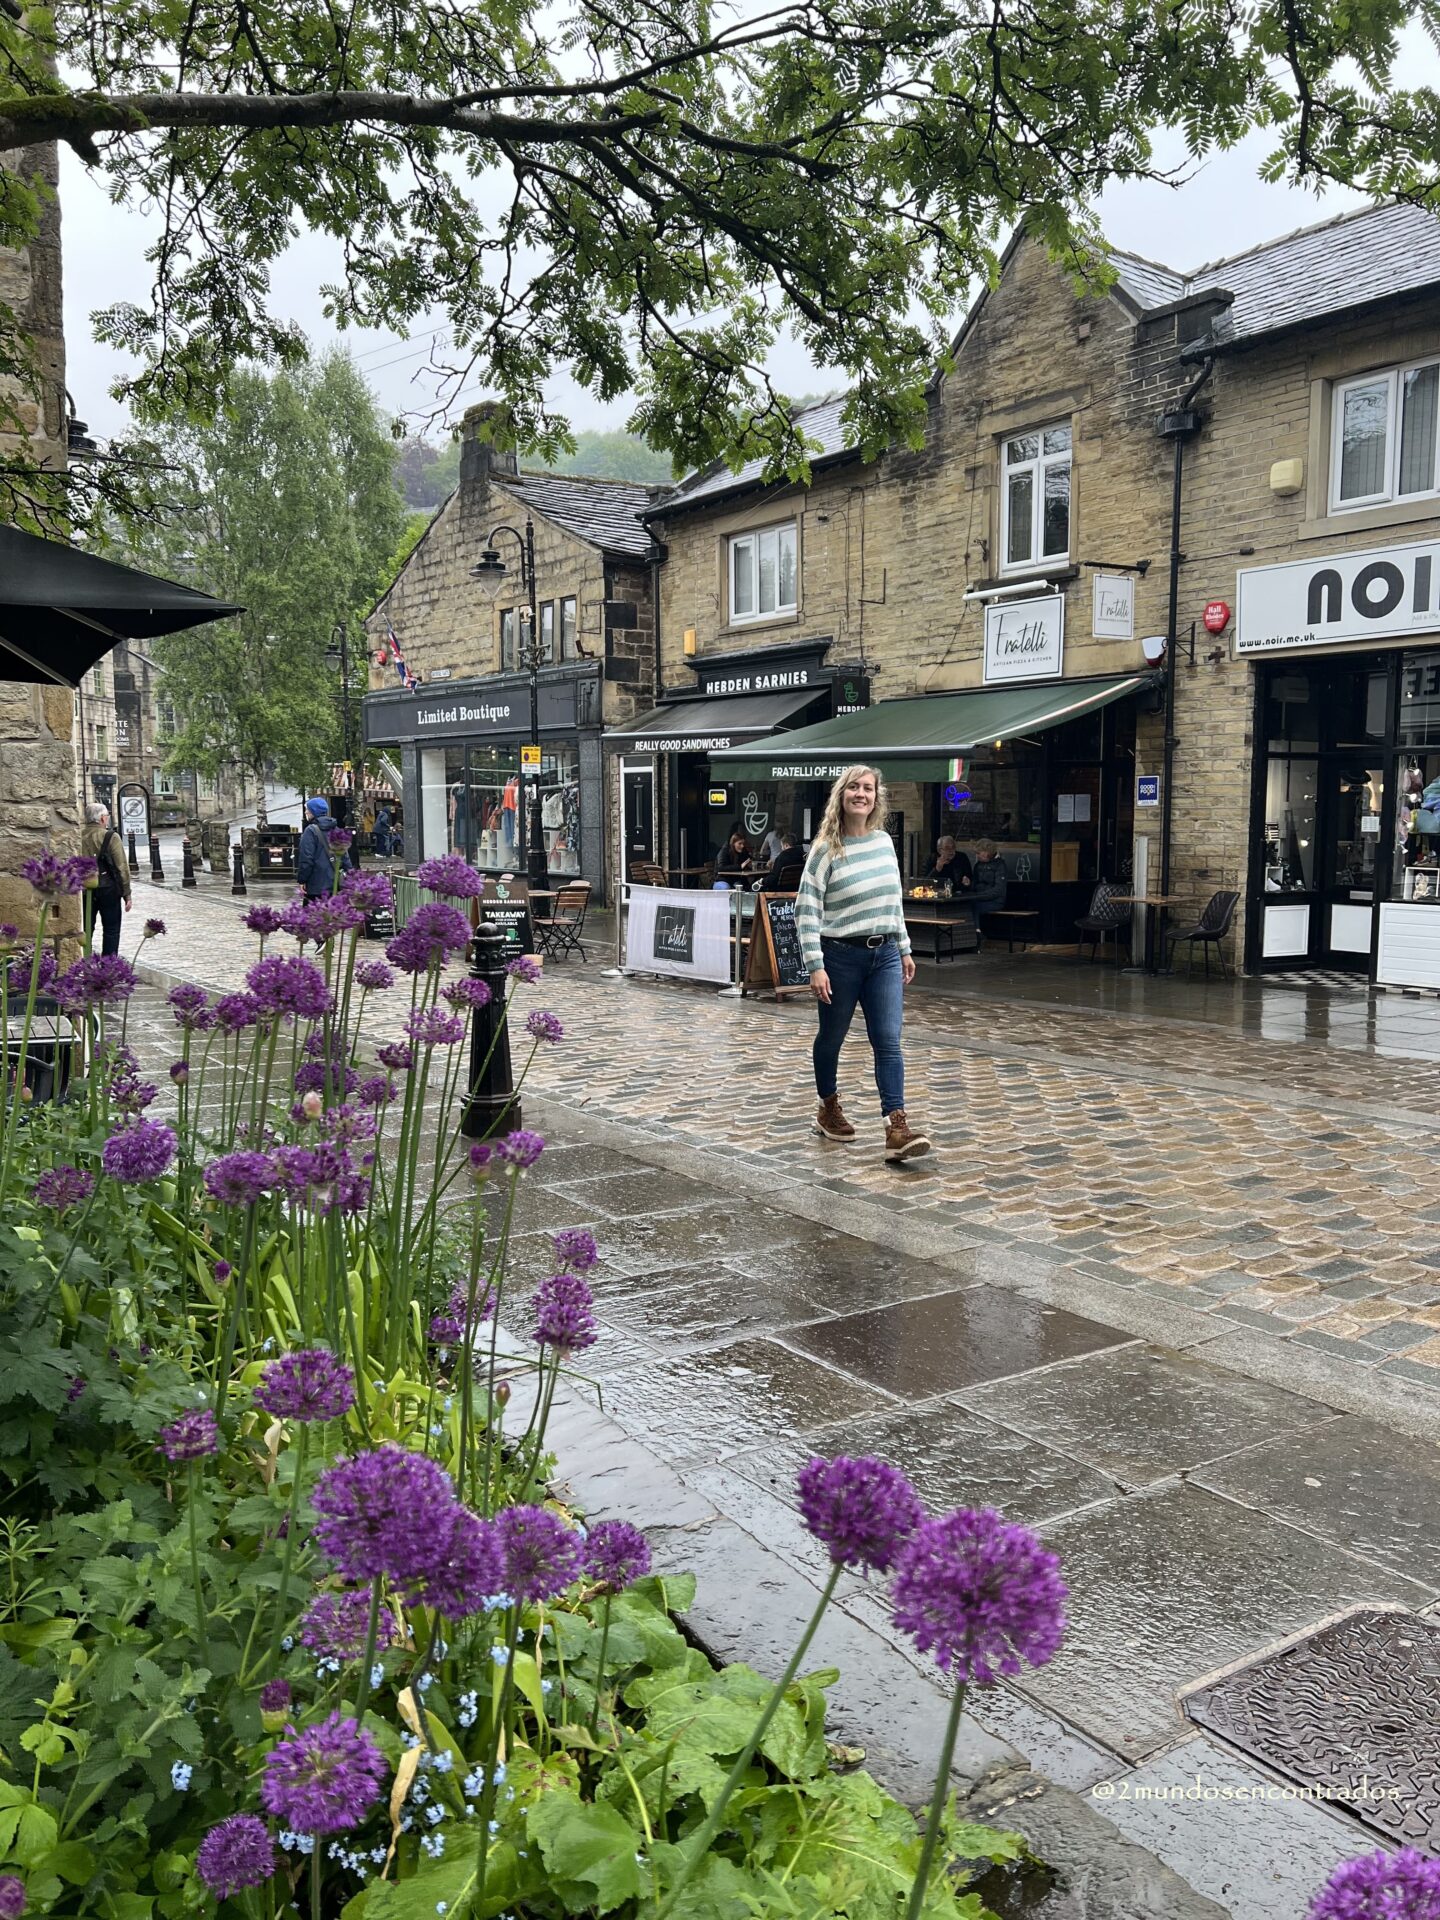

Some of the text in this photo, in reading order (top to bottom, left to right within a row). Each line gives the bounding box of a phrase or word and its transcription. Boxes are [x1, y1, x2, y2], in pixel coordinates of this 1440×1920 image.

[1307, 555, 1440, 625] NOI
[993, 611, 1049, 656] Fratelli
[1239, 632, 1316, 648] www.noir.me.uk
[706, 671, 808, 694] HEBDEN SARNIES
[417, 704, 510, 725] Limited Boutique
[635, 738, 730, 751] REALLY GOOD SANDWICHES
[772, 766, 848, 777] FRATELLI OF HEB
[767, 900, 795, 916] Fratel
